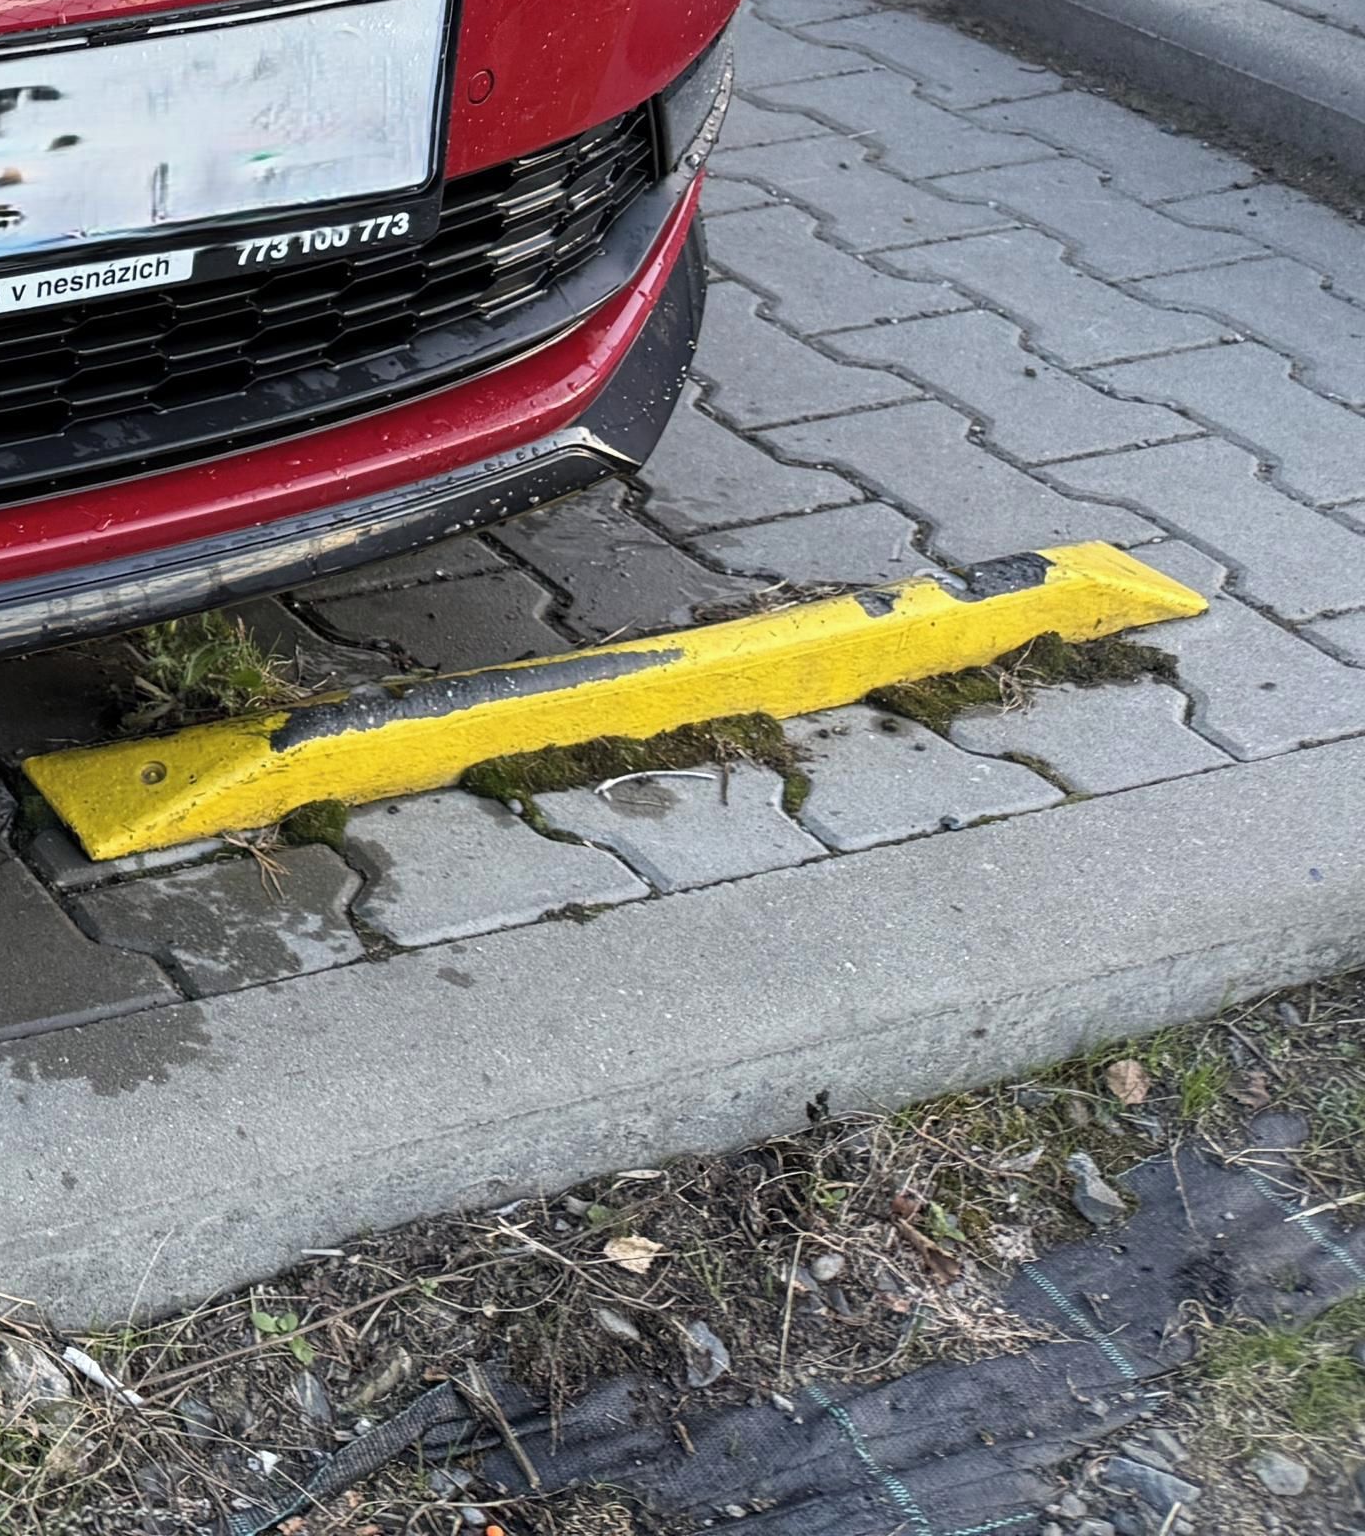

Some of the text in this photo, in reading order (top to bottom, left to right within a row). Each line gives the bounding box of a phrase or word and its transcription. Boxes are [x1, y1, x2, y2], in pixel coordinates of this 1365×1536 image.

[236, 212, 411, 266] 773 100 773
[11, 284, 27, 302] v
[36, 255, 170, 298] nesnázích
